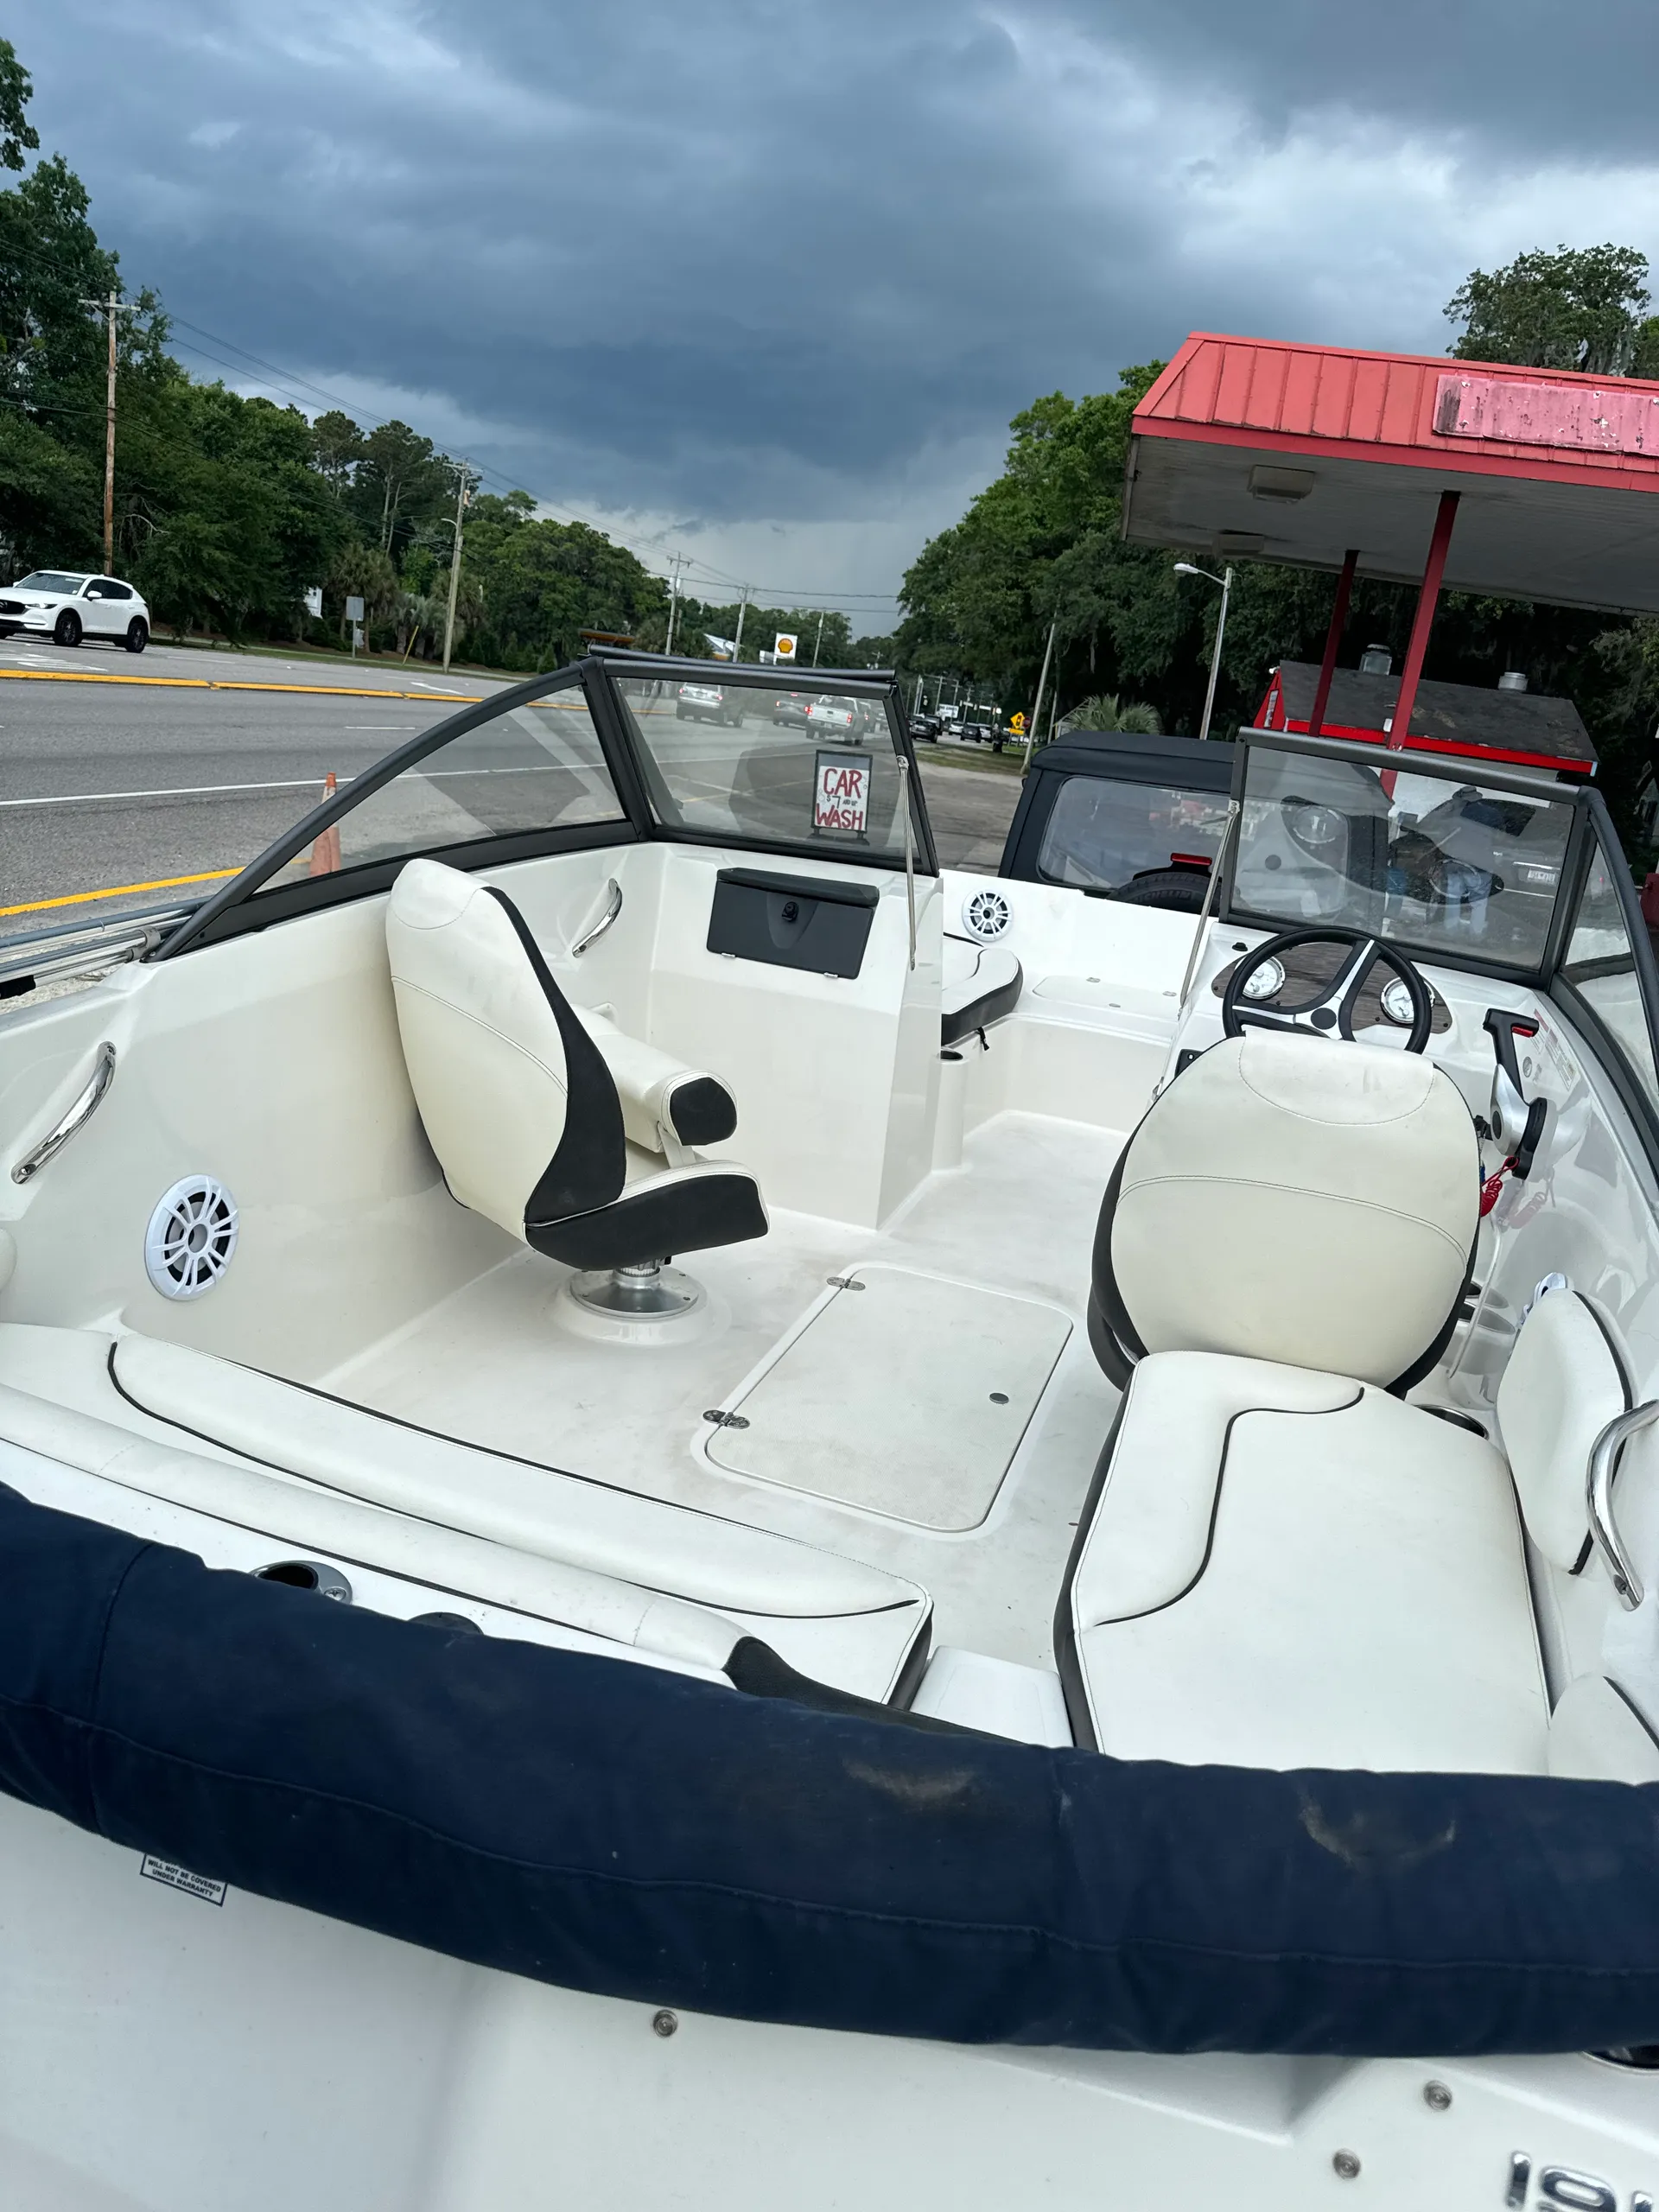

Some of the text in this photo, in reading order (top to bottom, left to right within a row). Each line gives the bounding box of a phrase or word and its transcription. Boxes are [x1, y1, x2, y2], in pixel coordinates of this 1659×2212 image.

[823, 768, 863, 798] CAR
[816, 803, 863, 830] WASH
[148, 1859, 163, 1870] WILL
[165, 1865, 179, 1875] NOT
[180, 1871, 189, 1879] BE
[190, 1875, 221, 1892] COVERED
[152, 1868, 213, 1897] UNDER WARRANTY
